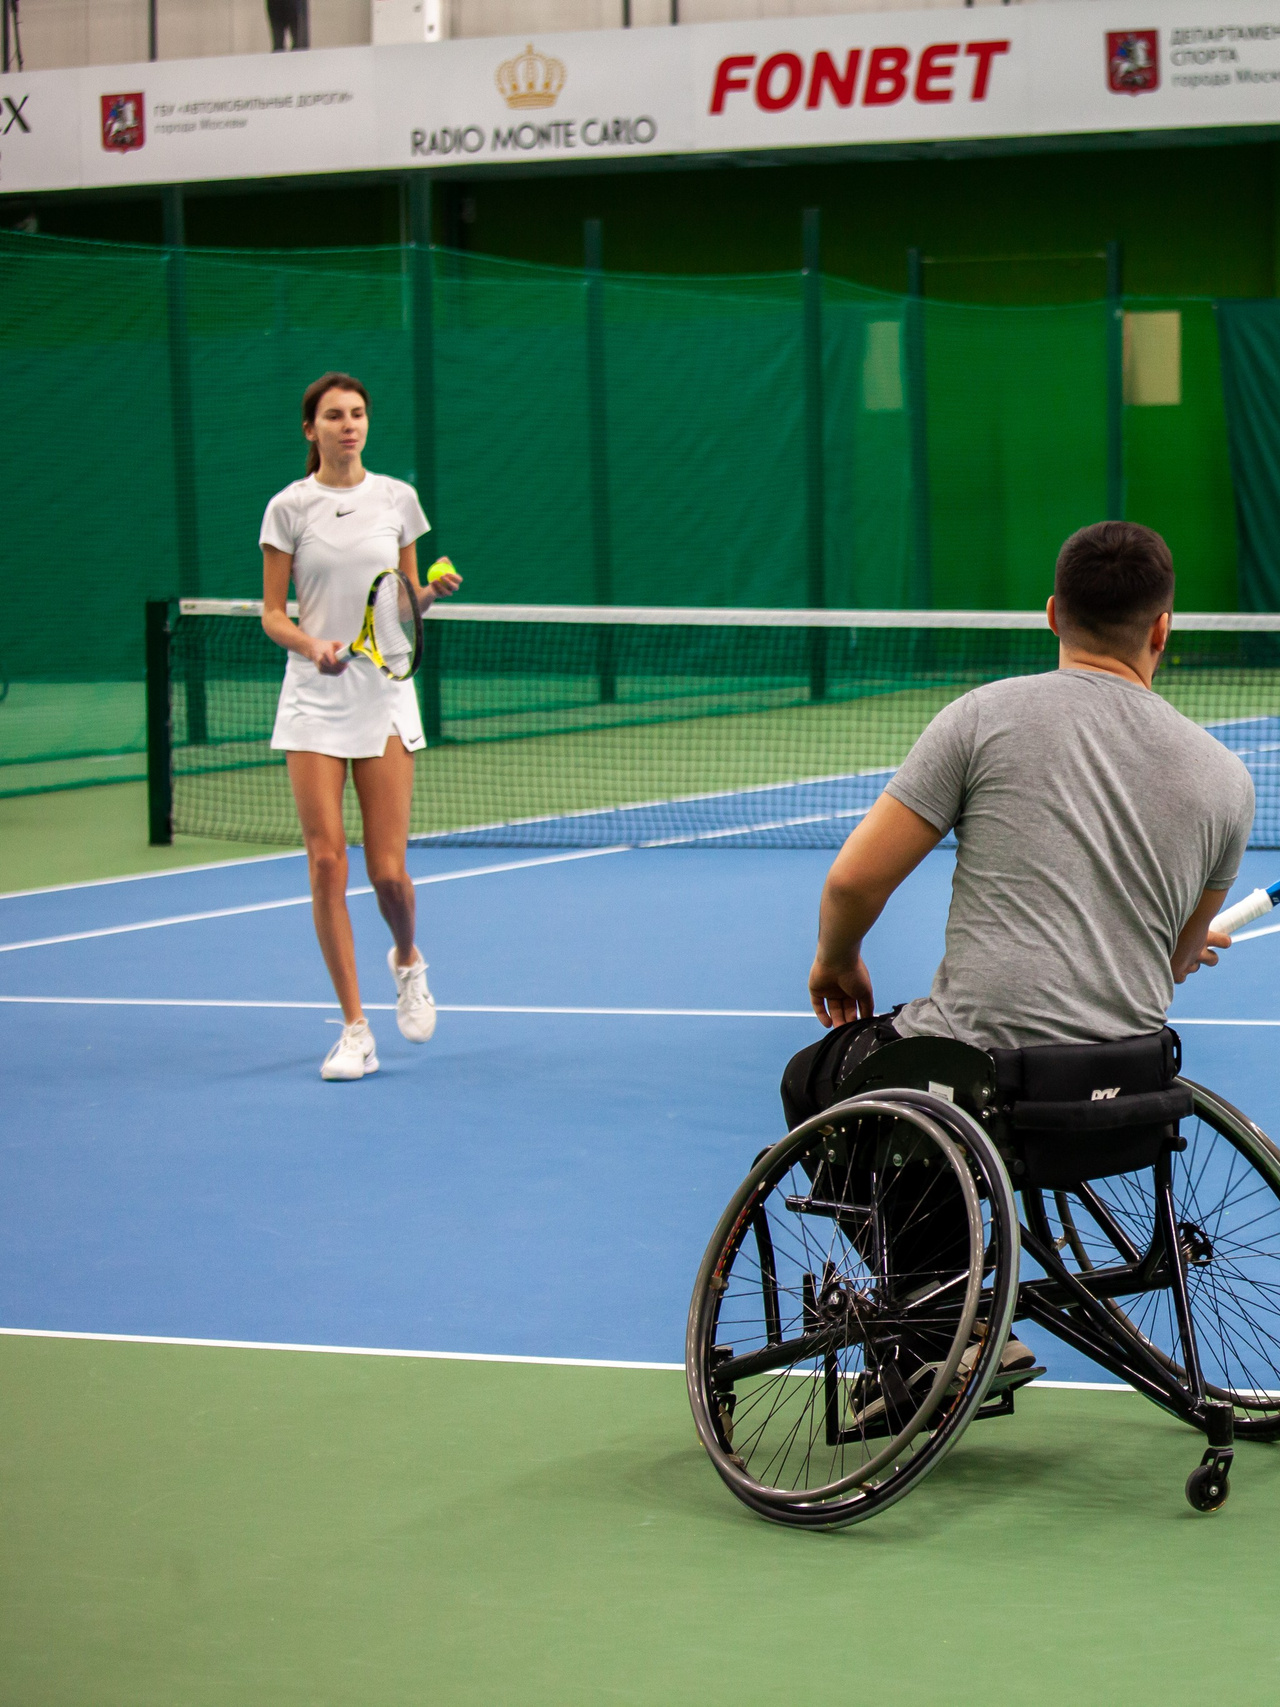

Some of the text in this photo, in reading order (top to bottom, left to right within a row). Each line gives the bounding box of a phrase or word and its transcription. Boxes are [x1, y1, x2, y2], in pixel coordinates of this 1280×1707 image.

[1170, 46, 1237, 67] СПОРТА
[708, 39, 1011, 115] FONBET
[1171, 73, 1230, 89] города
[411, 114, 657, 157] RADIO MONTE CARLO
